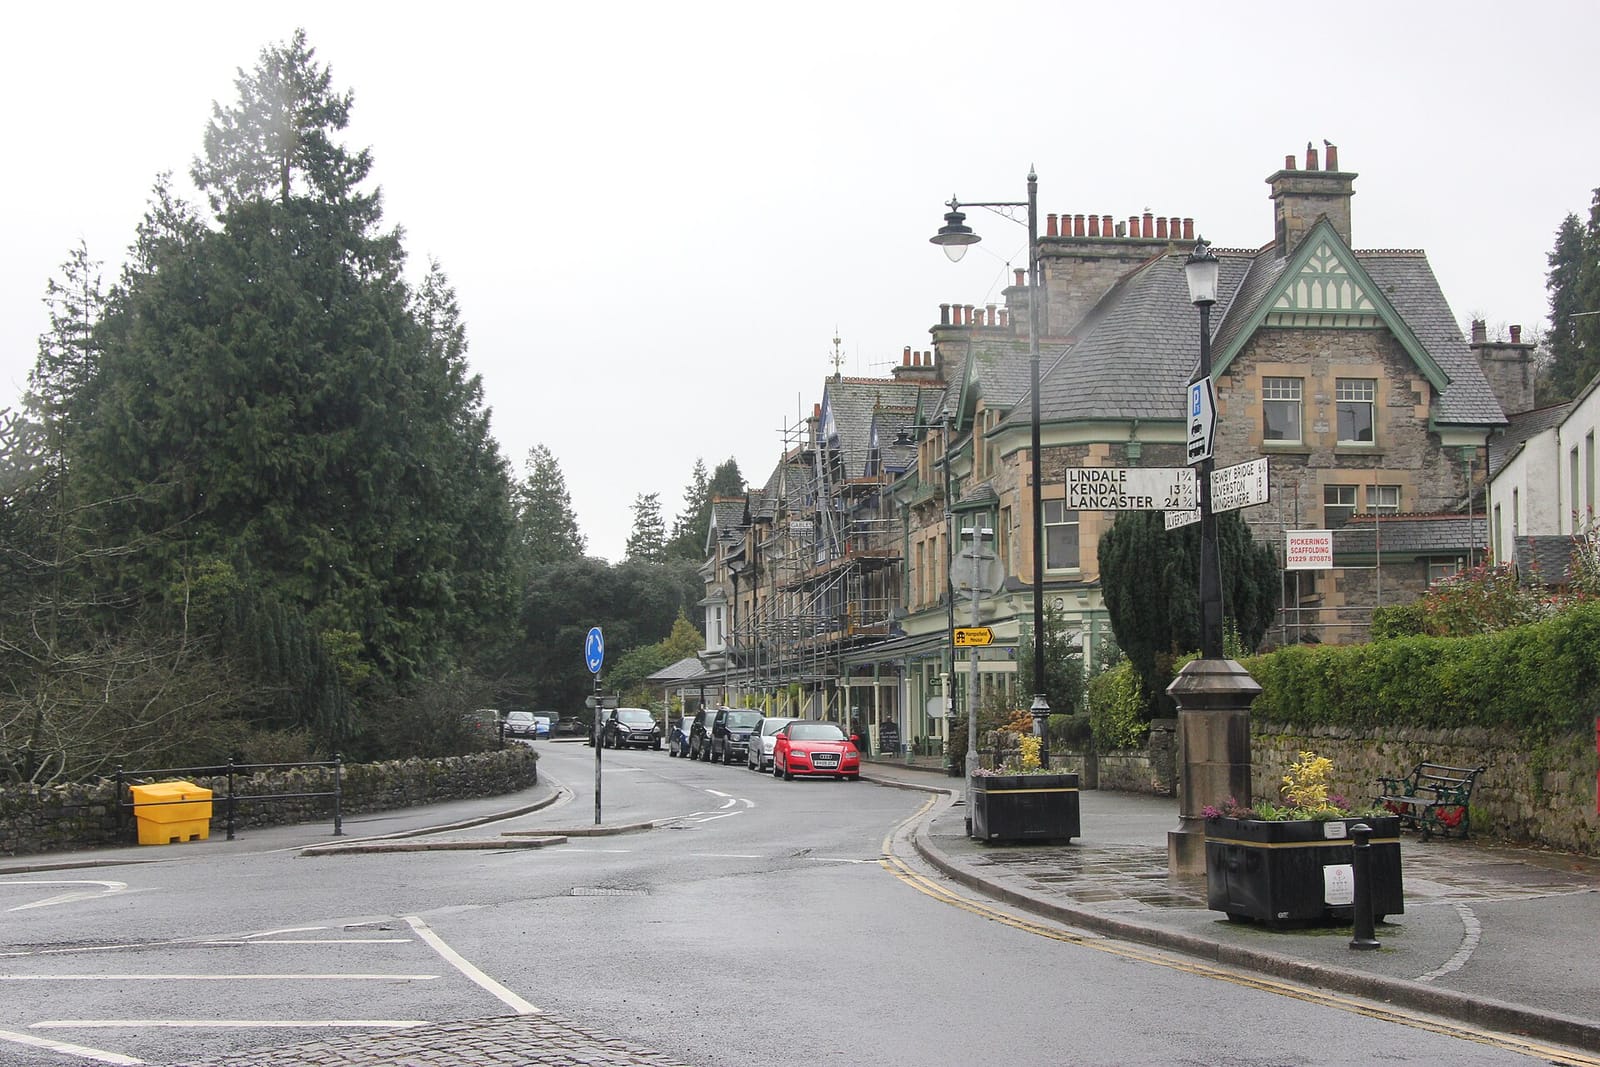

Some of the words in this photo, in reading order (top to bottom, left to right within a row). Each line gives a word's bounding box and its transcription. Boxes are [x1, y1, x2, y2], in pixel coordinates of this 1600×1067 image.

[1069, 470, 1127, 482] LINDALE
[1211, 467, 1232, 484] NEWBY
[1233, 463, 1254, 480] BRIDGE
[1070, 483, 1127, 495] KENDAL
[1212, 479, 1246, 498] ULVERSTON
[1070, 496, 1154, 508] LANCASTER
[1290, 538, 1329, 546] PICKERINGS
[1290, 546, 1329, 554] SCAFFOLDING
